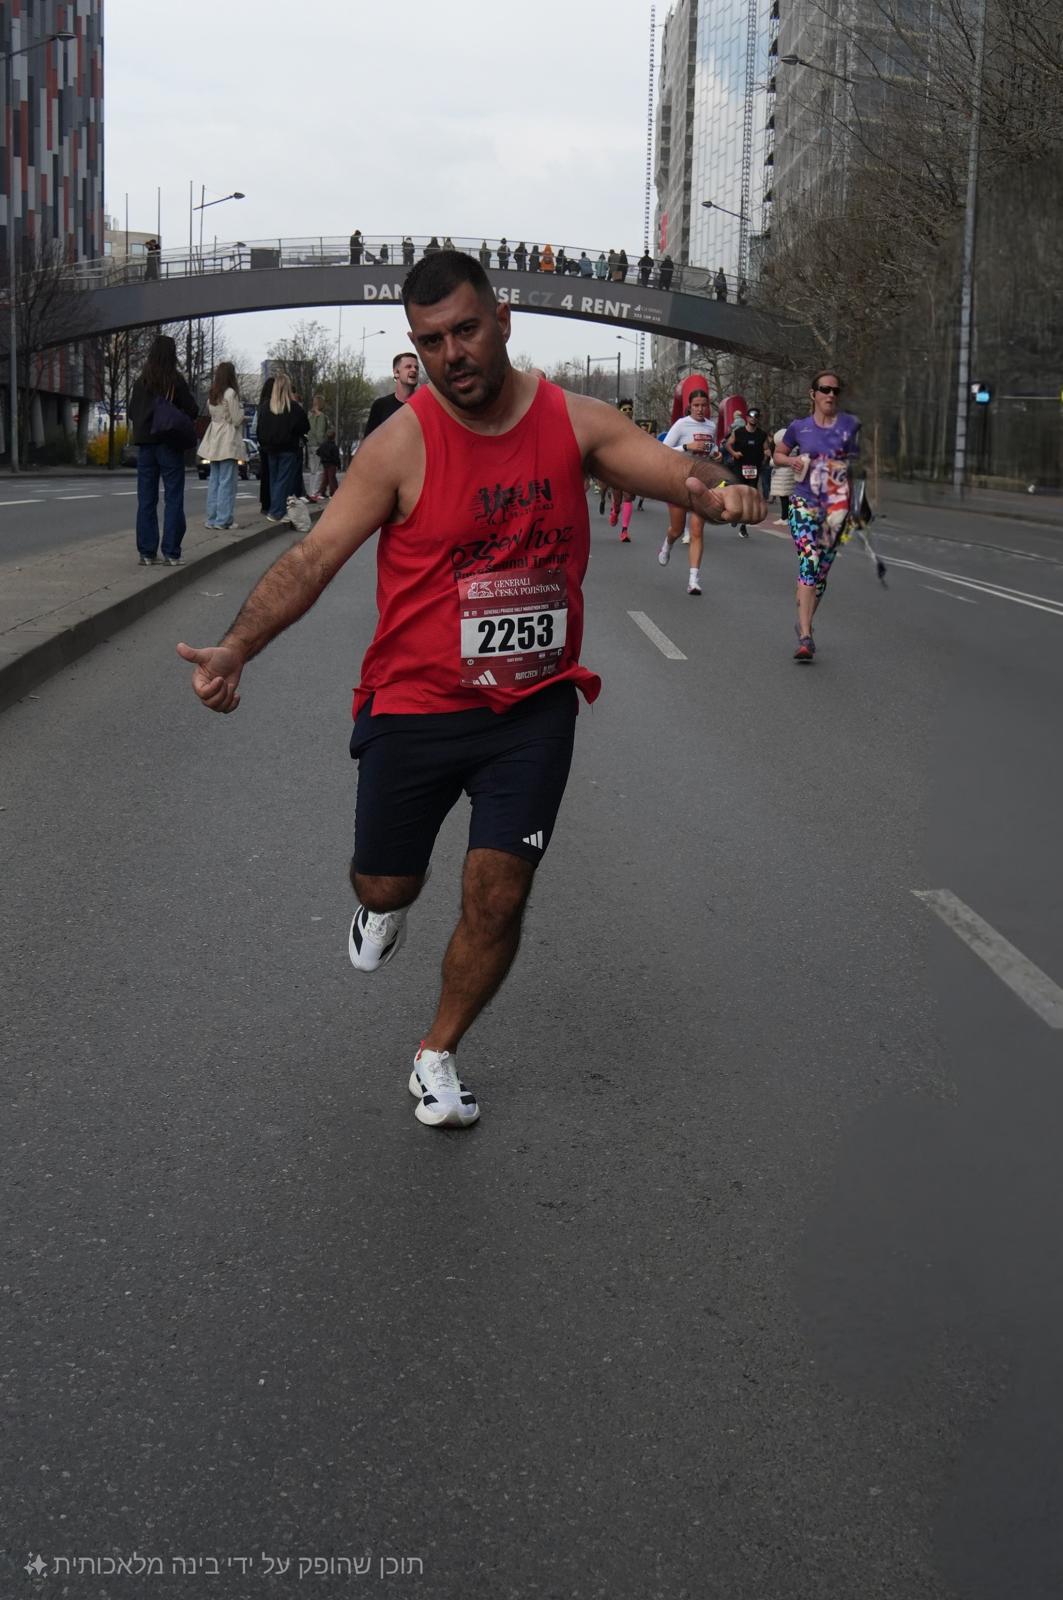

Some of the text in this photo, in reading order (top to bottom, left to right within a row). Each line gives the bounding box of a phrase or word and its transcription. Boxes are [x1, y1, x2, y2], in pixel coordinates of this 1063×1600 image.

[363, 283, 403, 300] DAN
[492, 286, 520, 304] SE
[560, 294, 574, 310] 4
[581, 296, 631, 319] RENT
[494, 577, 531, 588] GENERALI
[478, 613, 554, 654] 2253
